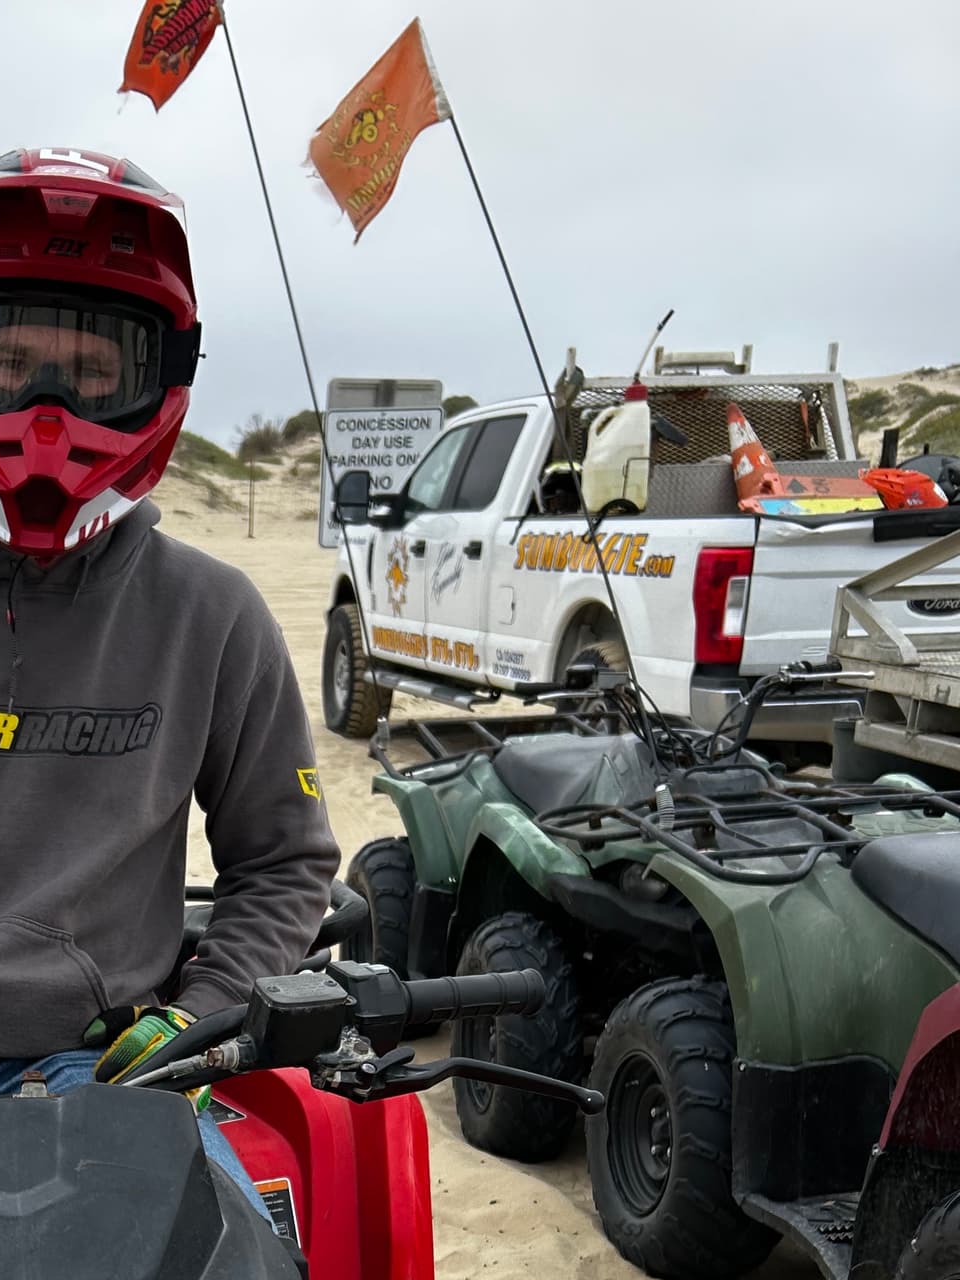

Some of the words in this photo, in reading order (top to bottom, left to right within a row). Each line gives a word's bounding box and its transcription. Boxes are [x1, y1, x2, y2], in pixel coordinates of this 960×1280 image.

[44, 237, 88, 257] FOX
[336, 418, 432, 431] CONCESSION
[352, 437, 381, 449] DAY
[384, 436, 414, 448] USE
[330, 454, 392, 467] PARKING
[396, 453, 420, 466] ON
[15, 708, 156, 754] RACING
